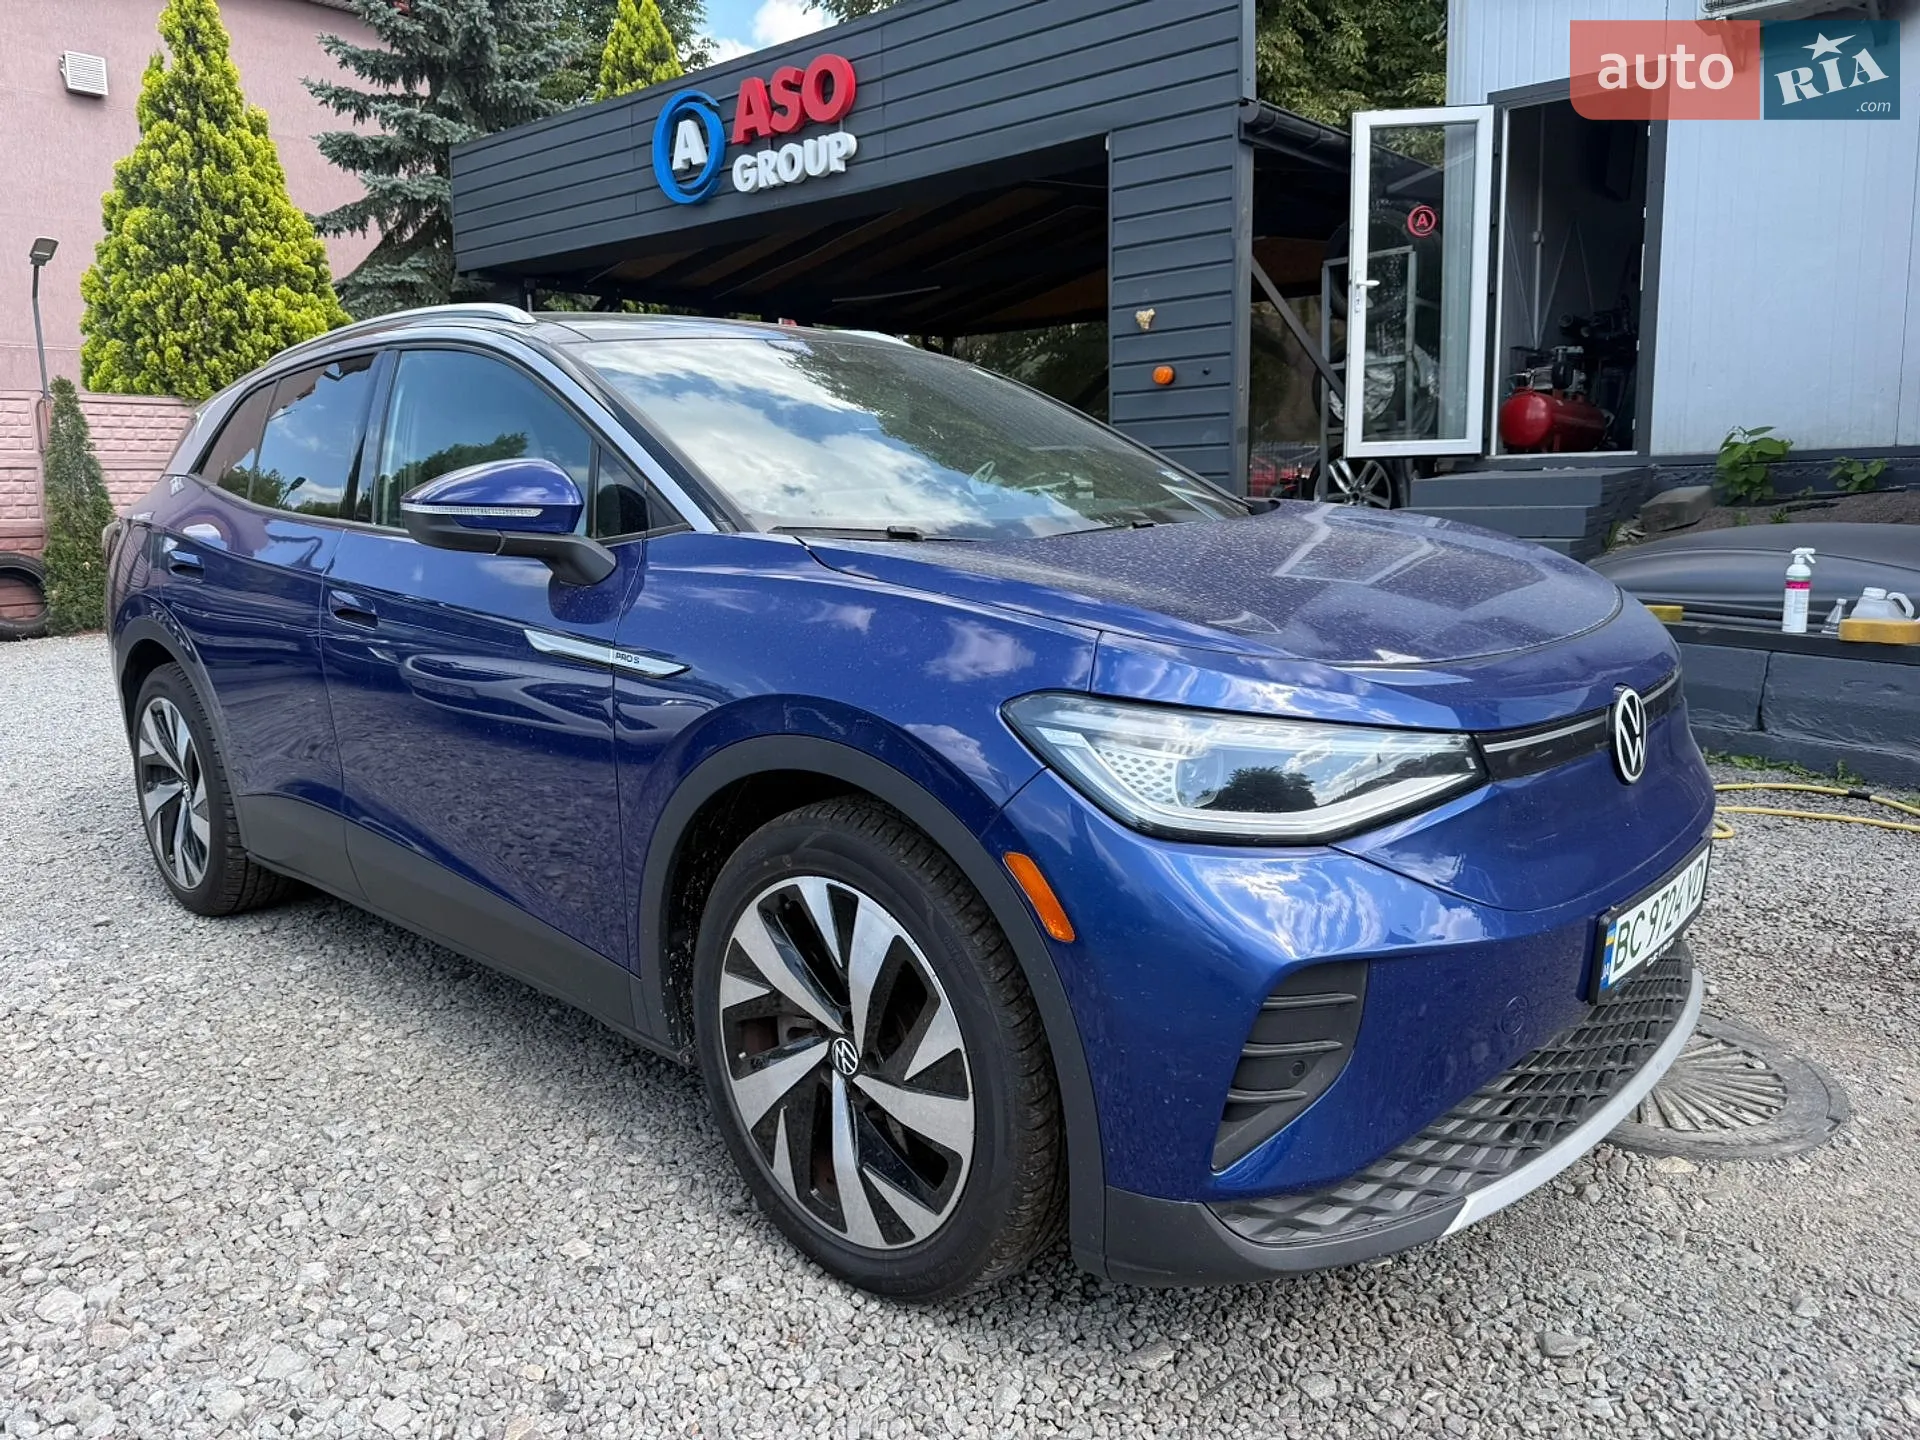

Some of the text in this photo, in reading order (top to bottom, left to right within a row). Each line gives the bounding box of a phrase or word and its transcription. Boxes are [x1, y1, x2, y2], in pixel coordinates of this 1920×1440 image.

[732, 53, 857, 145] ASO
[672, 118, 708, 171] A
[732, 131, 858, 193] GROUP
[1613, 910, 1645, 973] BC
[1645, 875, 1686, 948] 9724
